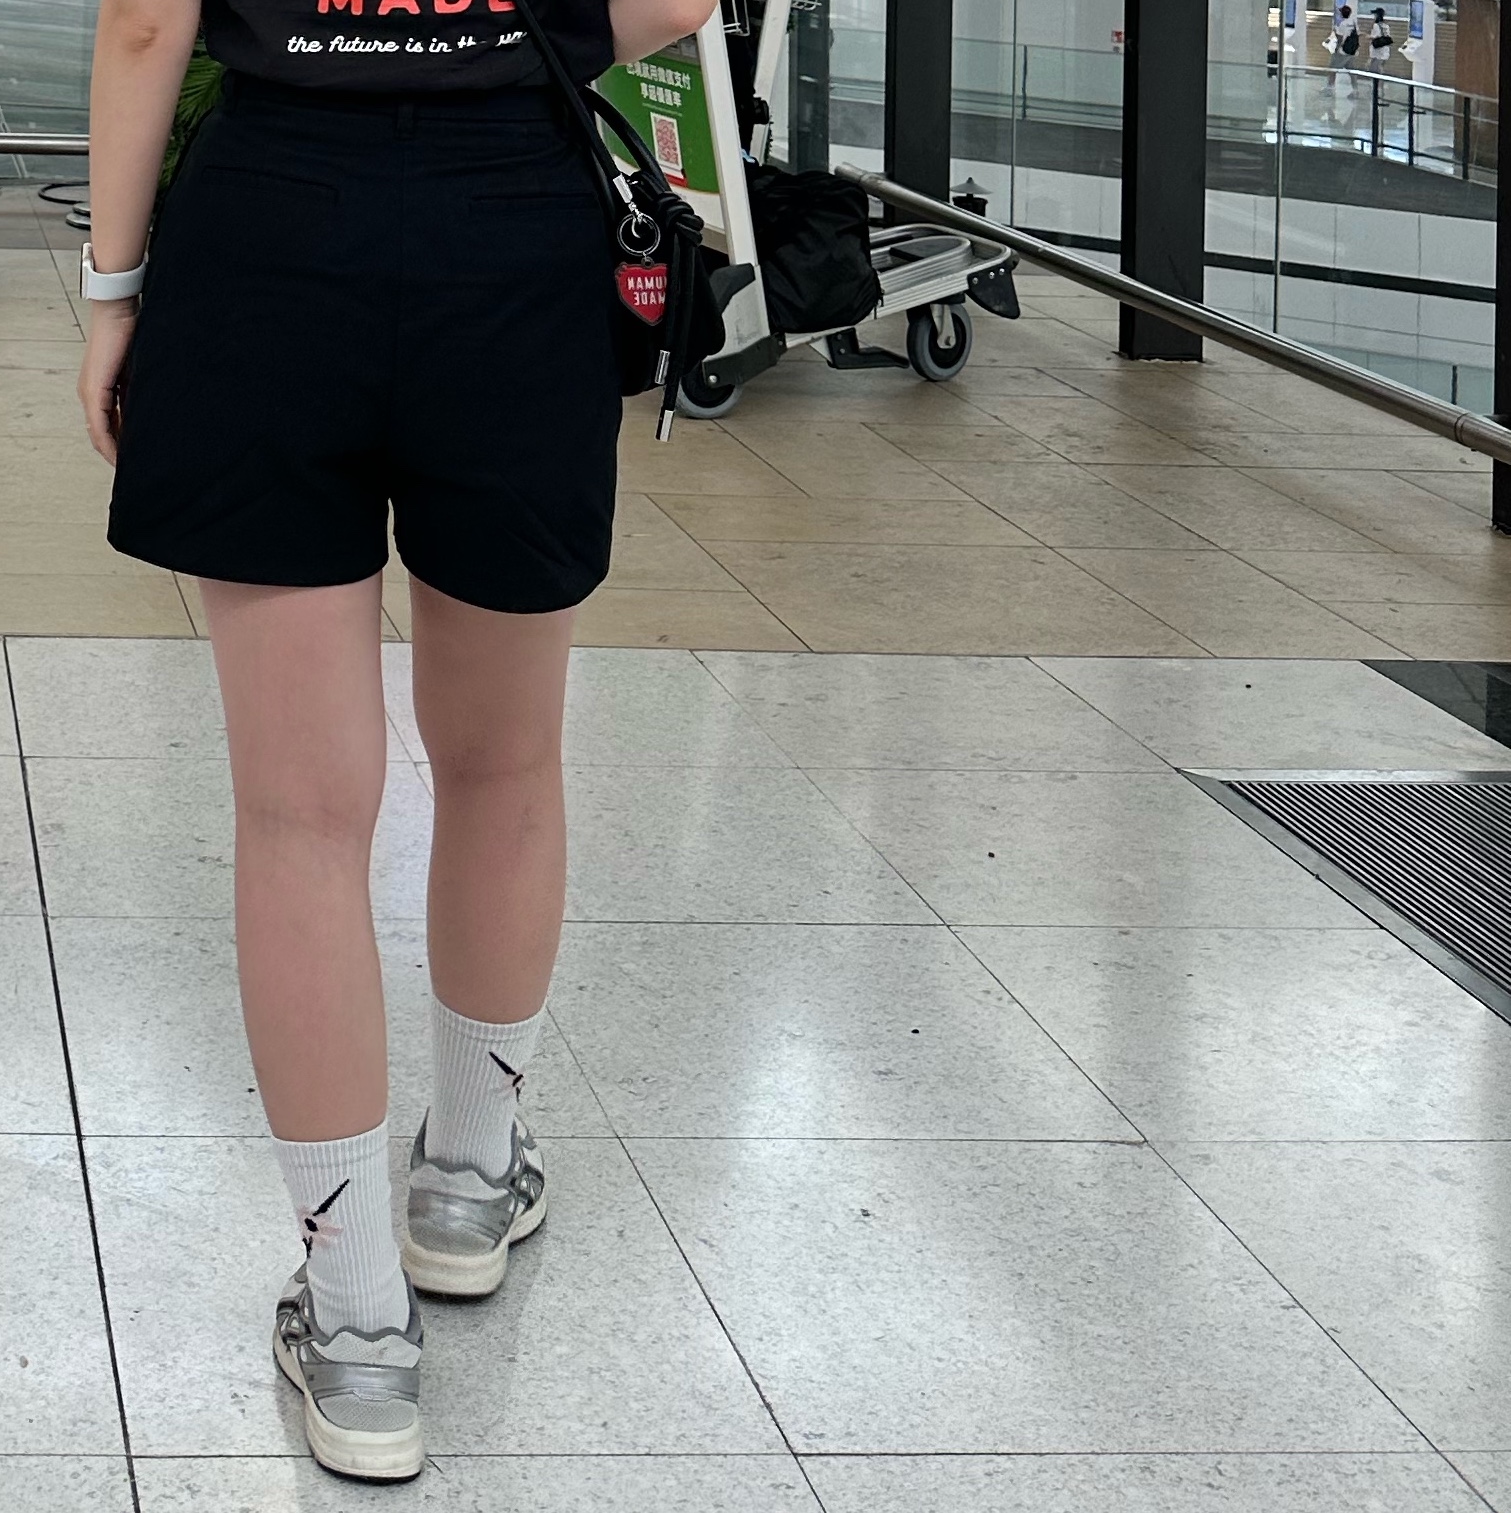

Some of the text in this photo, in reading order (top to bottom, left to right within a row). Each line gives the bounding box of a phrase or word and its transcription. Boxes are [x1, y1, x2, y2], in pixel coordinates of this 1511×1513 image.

[287, 35, 324, 53] the
[328, 35, 401, 53] future
[404, 37, 425, 53] is
[428, 37, 453, 53] in
